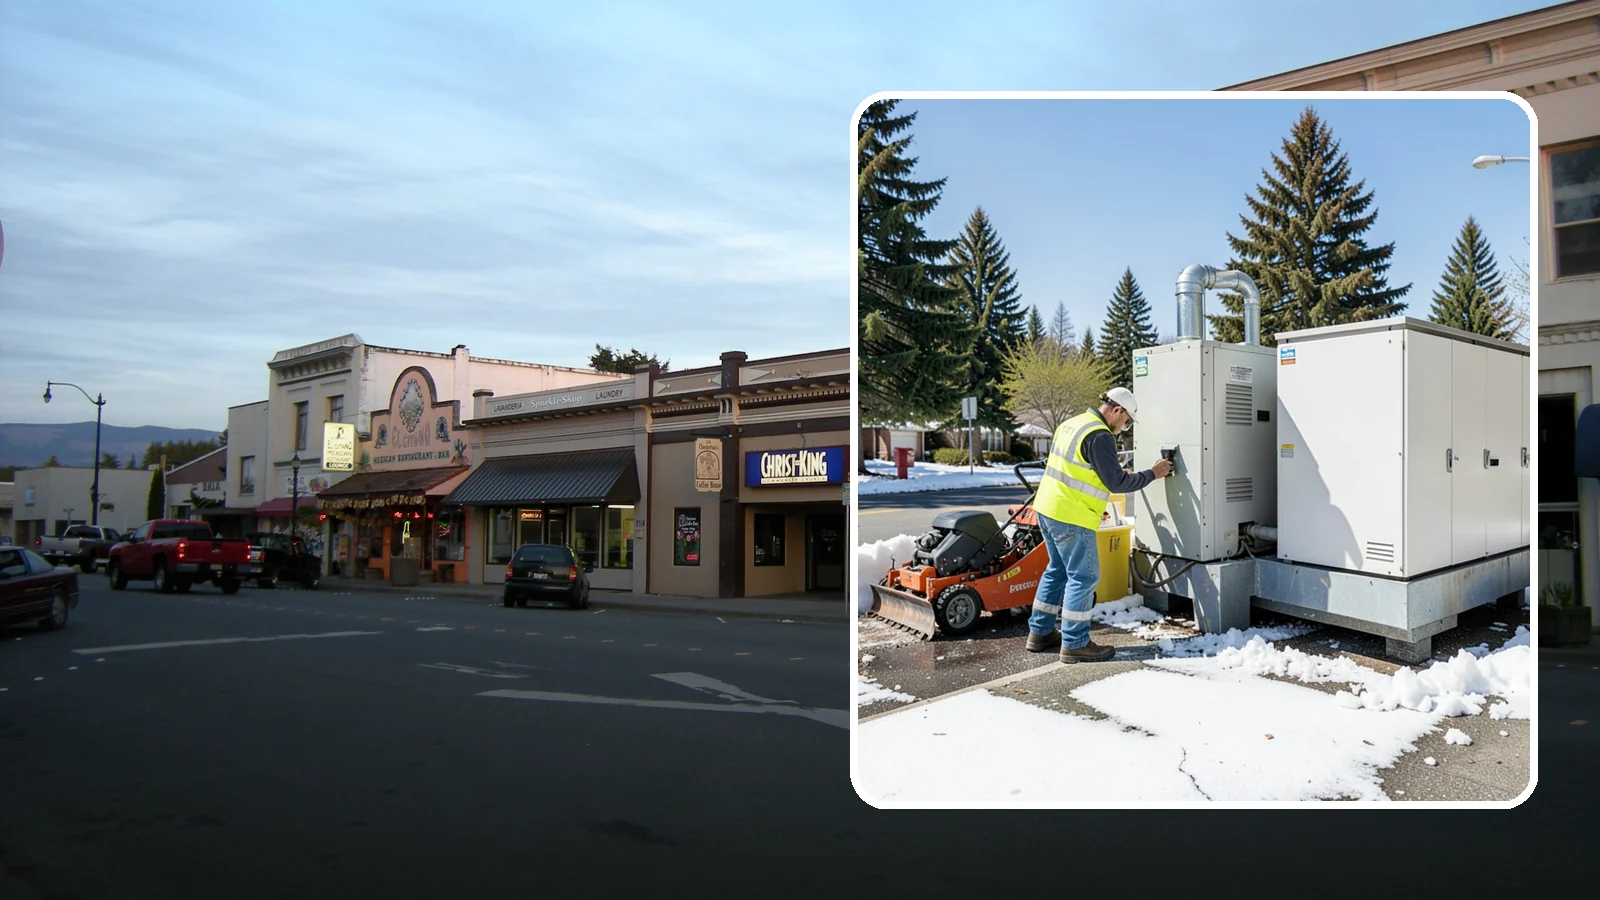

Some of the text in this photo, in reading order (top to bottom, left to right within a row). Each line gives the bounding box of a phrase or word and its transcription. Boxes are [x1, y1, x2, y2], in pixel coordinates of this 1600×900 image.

[595, 388, 624, 400] LAUNDRY
[493, 401, 523, 412] LAVANDERIA
[530, 394, 582, 409] Sparkle Shop
[397, 452, 433, 462] RESTAURANT
[438, 450, 450, 459] BAR
[761, 450, 827, 478] CHRIST KING
